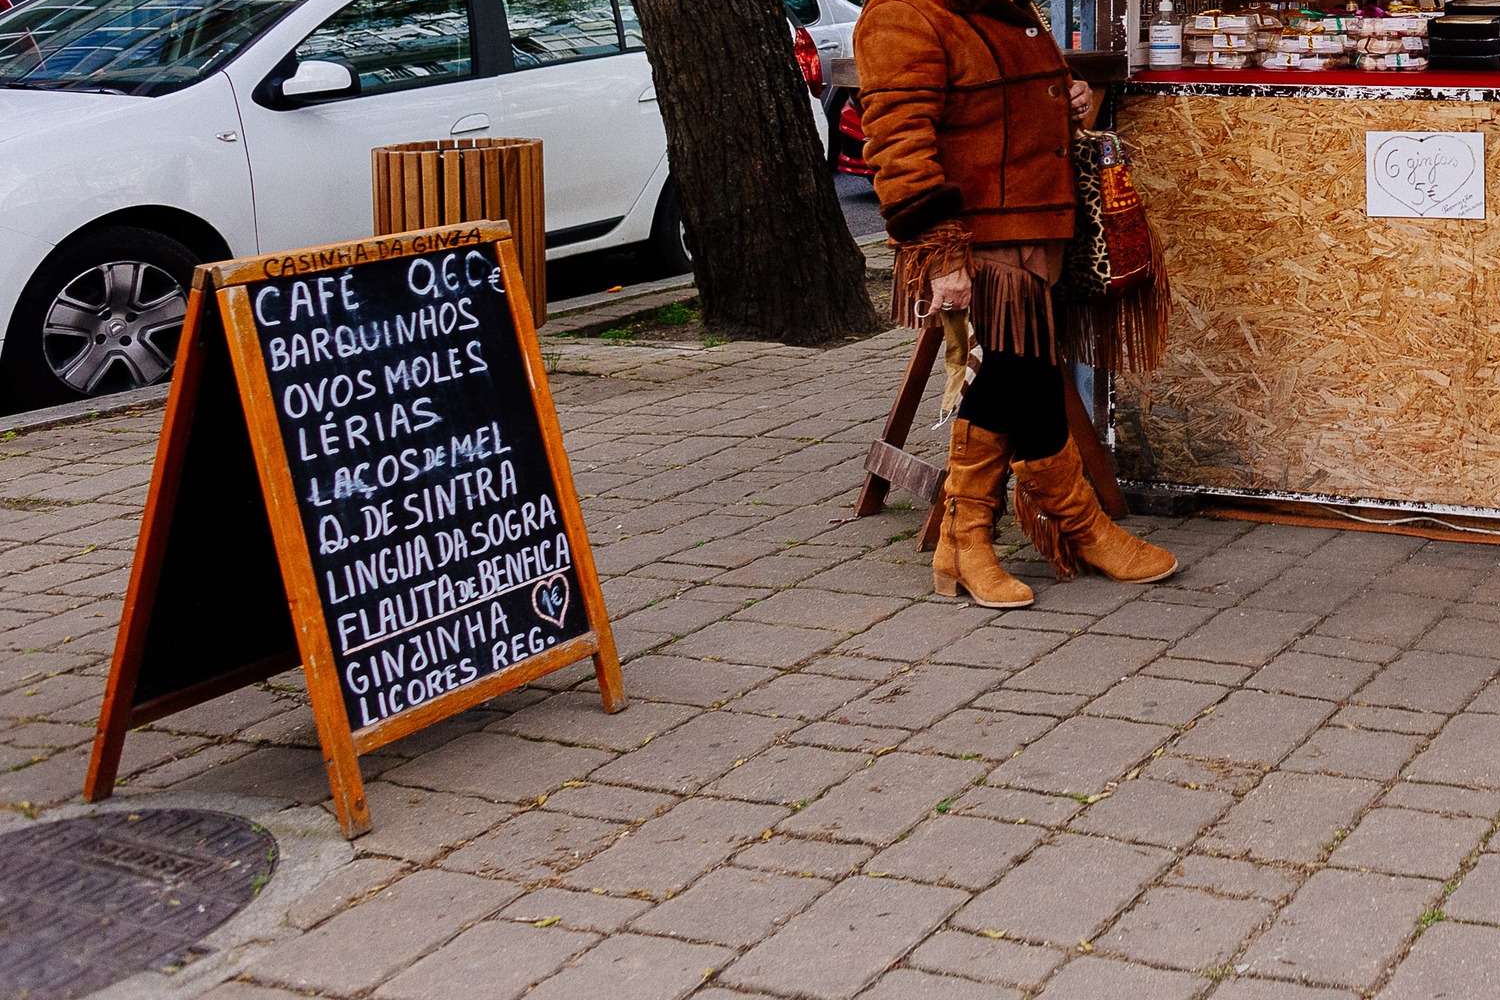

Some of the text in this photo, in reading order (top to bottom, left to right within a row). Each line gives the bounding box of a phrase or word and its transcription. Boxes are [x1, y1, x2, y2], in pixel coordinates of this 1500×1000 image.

[1385, 147, 1459, 186] 6 ginjas
[1411, 182, 1441, 206] 5€
[255, 266, 360, 327] CAFÉ
[264, 243, 368, 278] CASINHA
[374, 239, 403, 259] DA
[269, 297, 480, 372] BARQUINHOS
[283, 340, 488, 419] OVOS MOLES
[298, 397, 442, 462] LÉRIAS
[309, 421, 512, 508] LAÇOS DE MEL
[318, 458, 518, 555] Q. DE SINTRA
[326, 493, 557, 605] LINGUA DA SOGRA
[336, 532, 571, 651] FLAUTA DE BENFICA
[541, 585, 563, 616] 1€
[345, 600, 510, 695] GINJINHA
[359, 625, 556, 727] LICORES REG.
